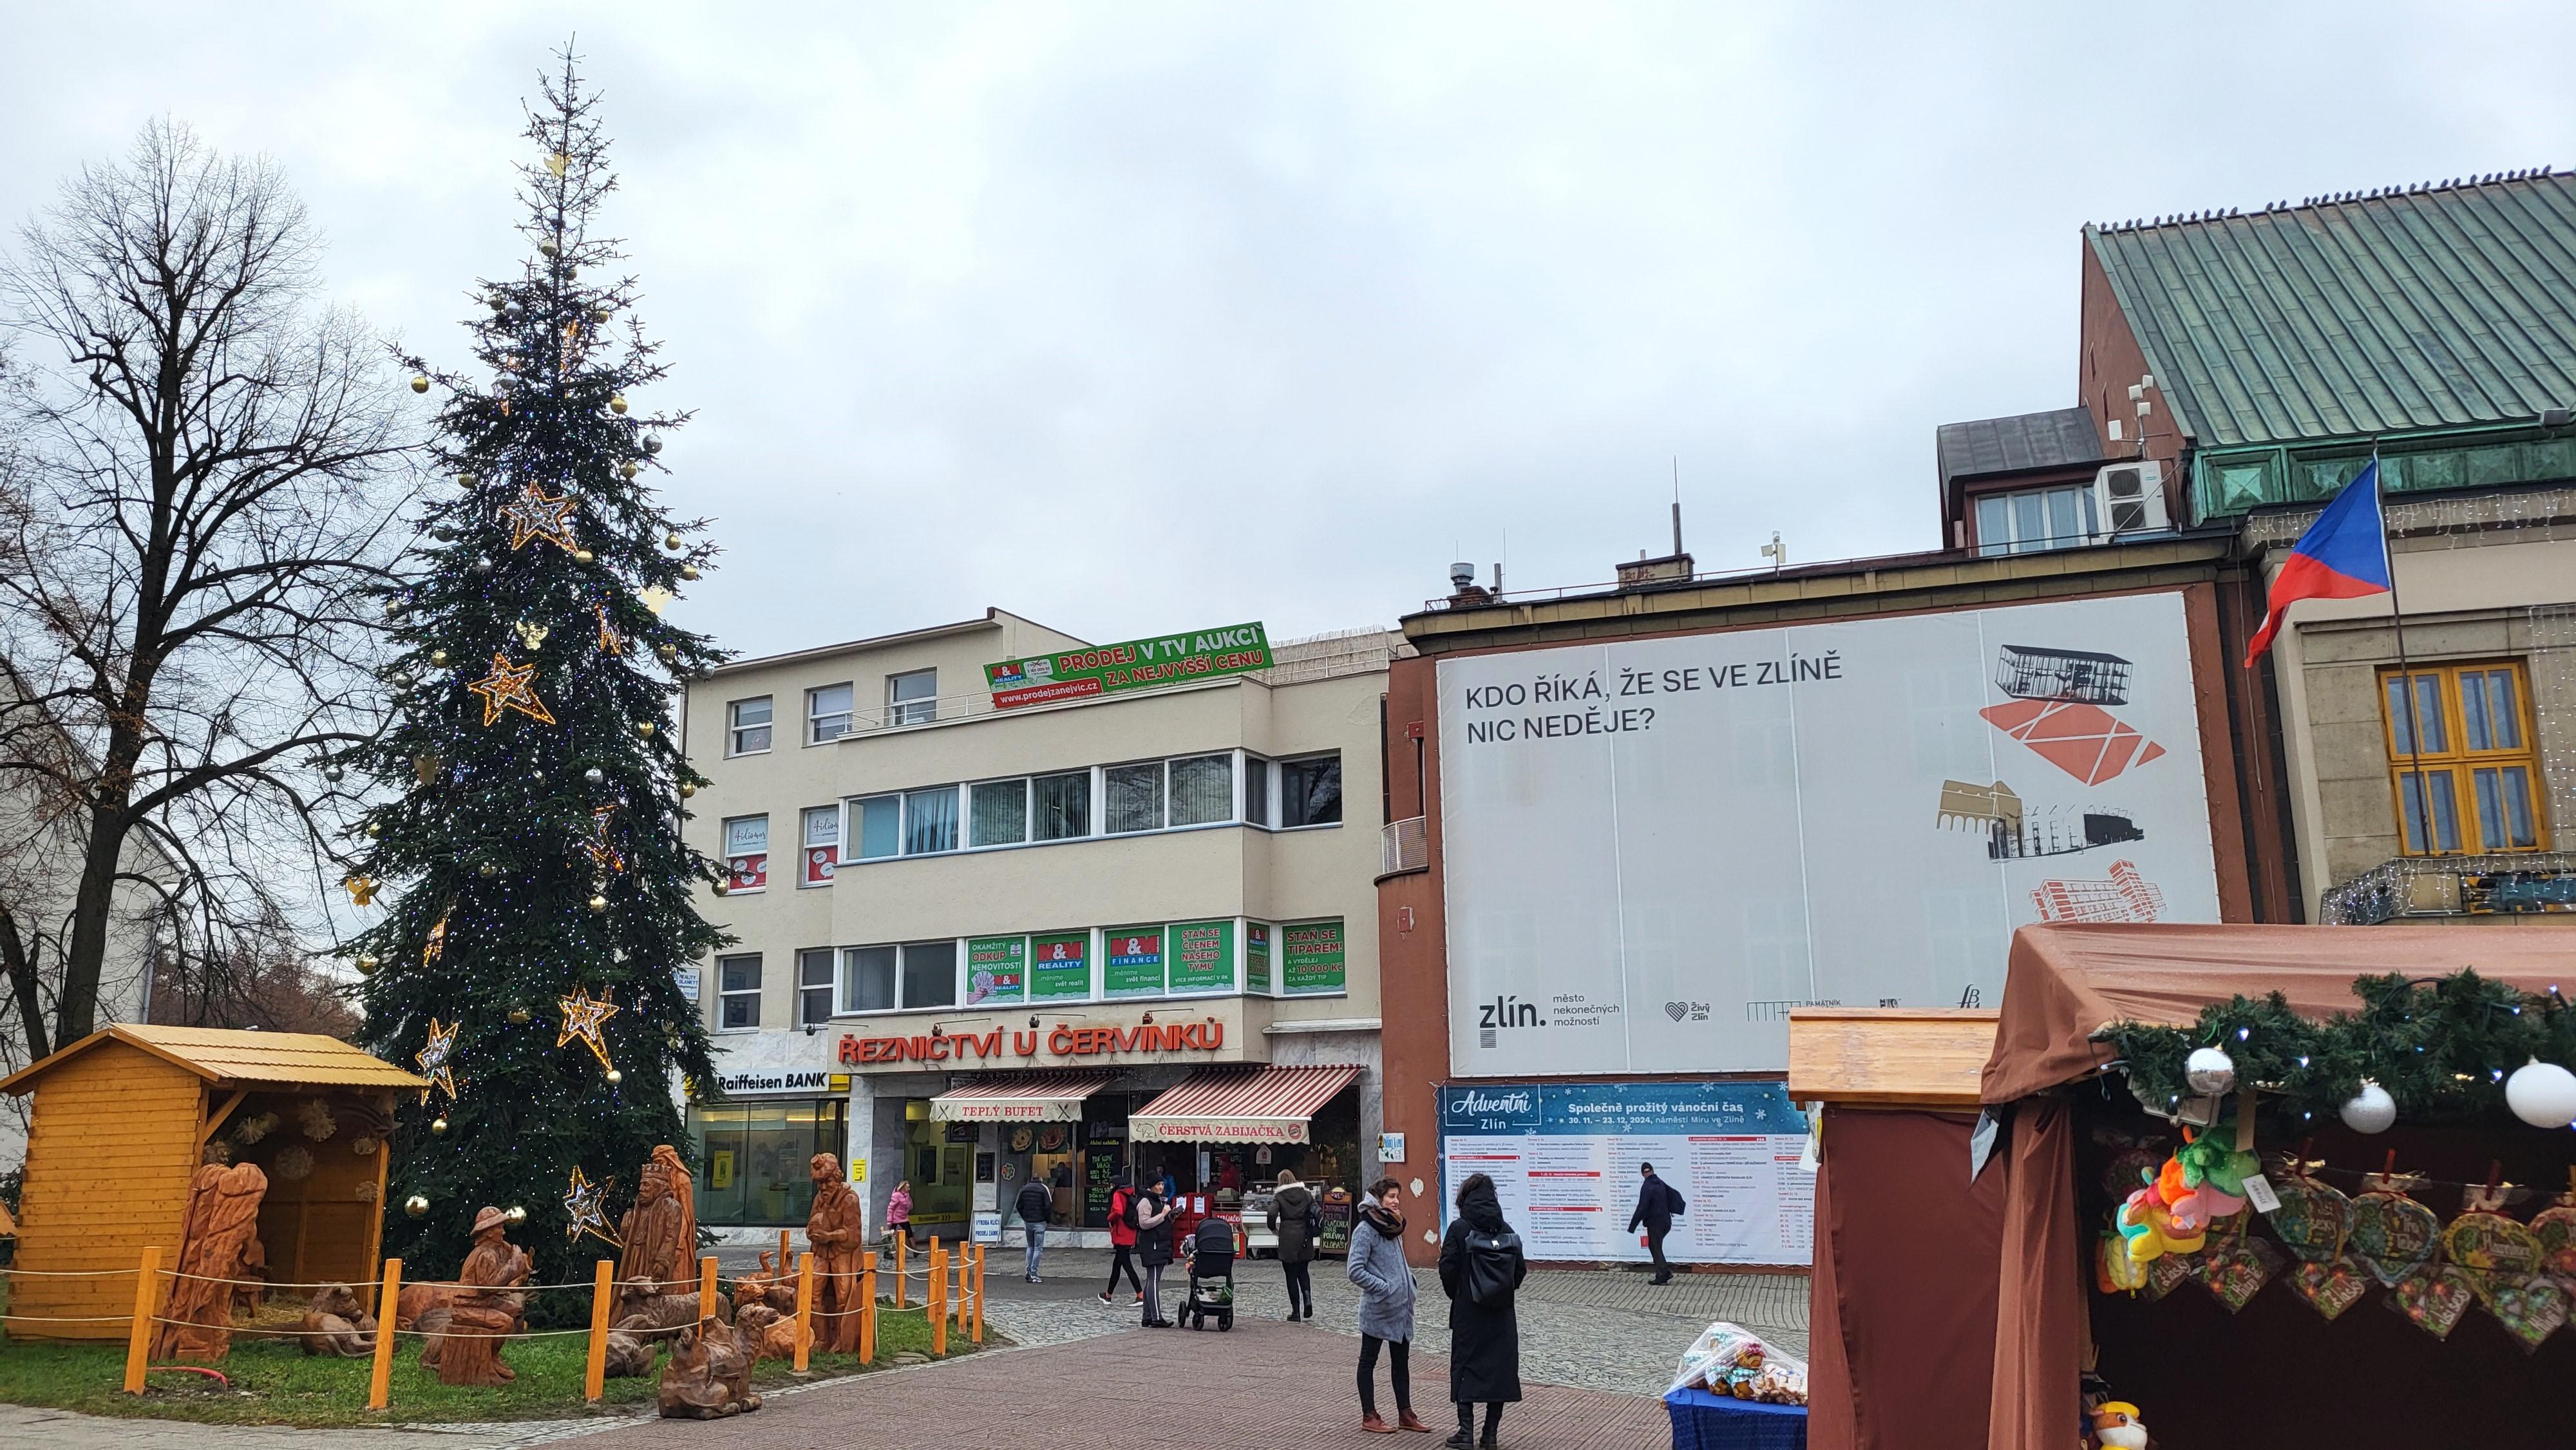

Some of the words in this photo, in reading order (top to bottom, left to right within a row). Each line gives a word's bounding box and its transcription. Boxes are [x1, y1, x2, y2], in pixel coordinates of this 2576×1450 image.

[1059, 646, 1137, 673] PRODEJ
[1140, 643, 1154, 660] V
[1162, 638, 1186, 657] TV
[1195, 626, 1259, 653] AUKCI
[1106, 669, 1130, 686] ZA
[1132, 654, 1212, 683] NEJVYŠŠÍ
[1216, 649, 1264, 670] CENU
[1466, 683, 1526, 710] KDO
[1534, 670, 1611, 704] ŘÍKÁ,
[1620, 668, 1654, 696] ŽE
[1662, 668, 1700, 693] SE
[1708, 663, 1747, 689] VE
[1756, 650, 1842, 685] ZLÍNĚ
[999, 683, 1098, 704] www.prodejzanejvic.cz
[1467, 719, 1516, 744] NIC
[1523, 706, 1656, 740] NEDĚJE?
[814, 818, 838, 832] 4idiom
[734, 827, 766, 842] 4idiomas
[1182, 928, 1206, 939] STAŇ
[1208, 928, 1220, 937] SE
[1287, 928, 1318, 942] STAŇ
[1321, 929, 1336, 940] SE
[972, 942, 1006, 951] OKAMŽITÝ
[1037, 941, 1081, 961] M&M
[1111, 936, 1157, 956] M&M
[1182, 939, 1220, 950] ČLENEM
[1287, 941, 1343, 956] TIPAŘEM!
[972, 952, 1006, 962] ODKUP
[1182, 950, 1220, 961] NAŠEHO
[971, 960, 1022, 971] NEMOVITOSTÍ
[1038, 961, 1081, 970] REALITY
[1188, 961, 1215, 972] TÝMU
[1297, 965, 1308, 974] 10
[1310, 964, 1329, 973] 000
[1553, 1004, 1620, 1015] nekonečných
[1690, 1001, 1710, 1013] Živý
[1806, 999, 1842, 1007] PAMÁTNÍK
[1479, 995, 1547, 1028] zlín.
[1553, 993, 1585, 1003] město
[1554, 1016, 1600, 1026] možností
[838, 1025, 1005, 1063] ŘEZNICTVÍ
[1014, 1030, 1037, 1056] U
[718, 1074, 782, 1091] Raiffeisen
[785, 1072, 827, 1088] BANK
[962, 1104, 1001, 1116] TEPLÝ
[1004, 1106, 1044, 1116] BUFET
[1452, 1090, 1532, 1116] Adventní
[1567, 1102, 1623, 1115] Společně
[1625, 1102, 1668, 1115] prožitý
[1671, 1101, 1719, 1113] vánoční
[1722, 1101, 1744, 1113] čas
[1481, 1117, 1506, 1129] Zlín
[1630, 1116, 1653, 1125] 2024,
[1655, 1115, 1689, 1124] náměstí
[1690, 1115, 1710, 1124] Míru
[1723, 1115, 1745, 1124] Zlíně
[1159, 1122, 1213, 1136] ČERSTVÁ
[1215, 1123, 1285, 1138] ZABIJAČKA
